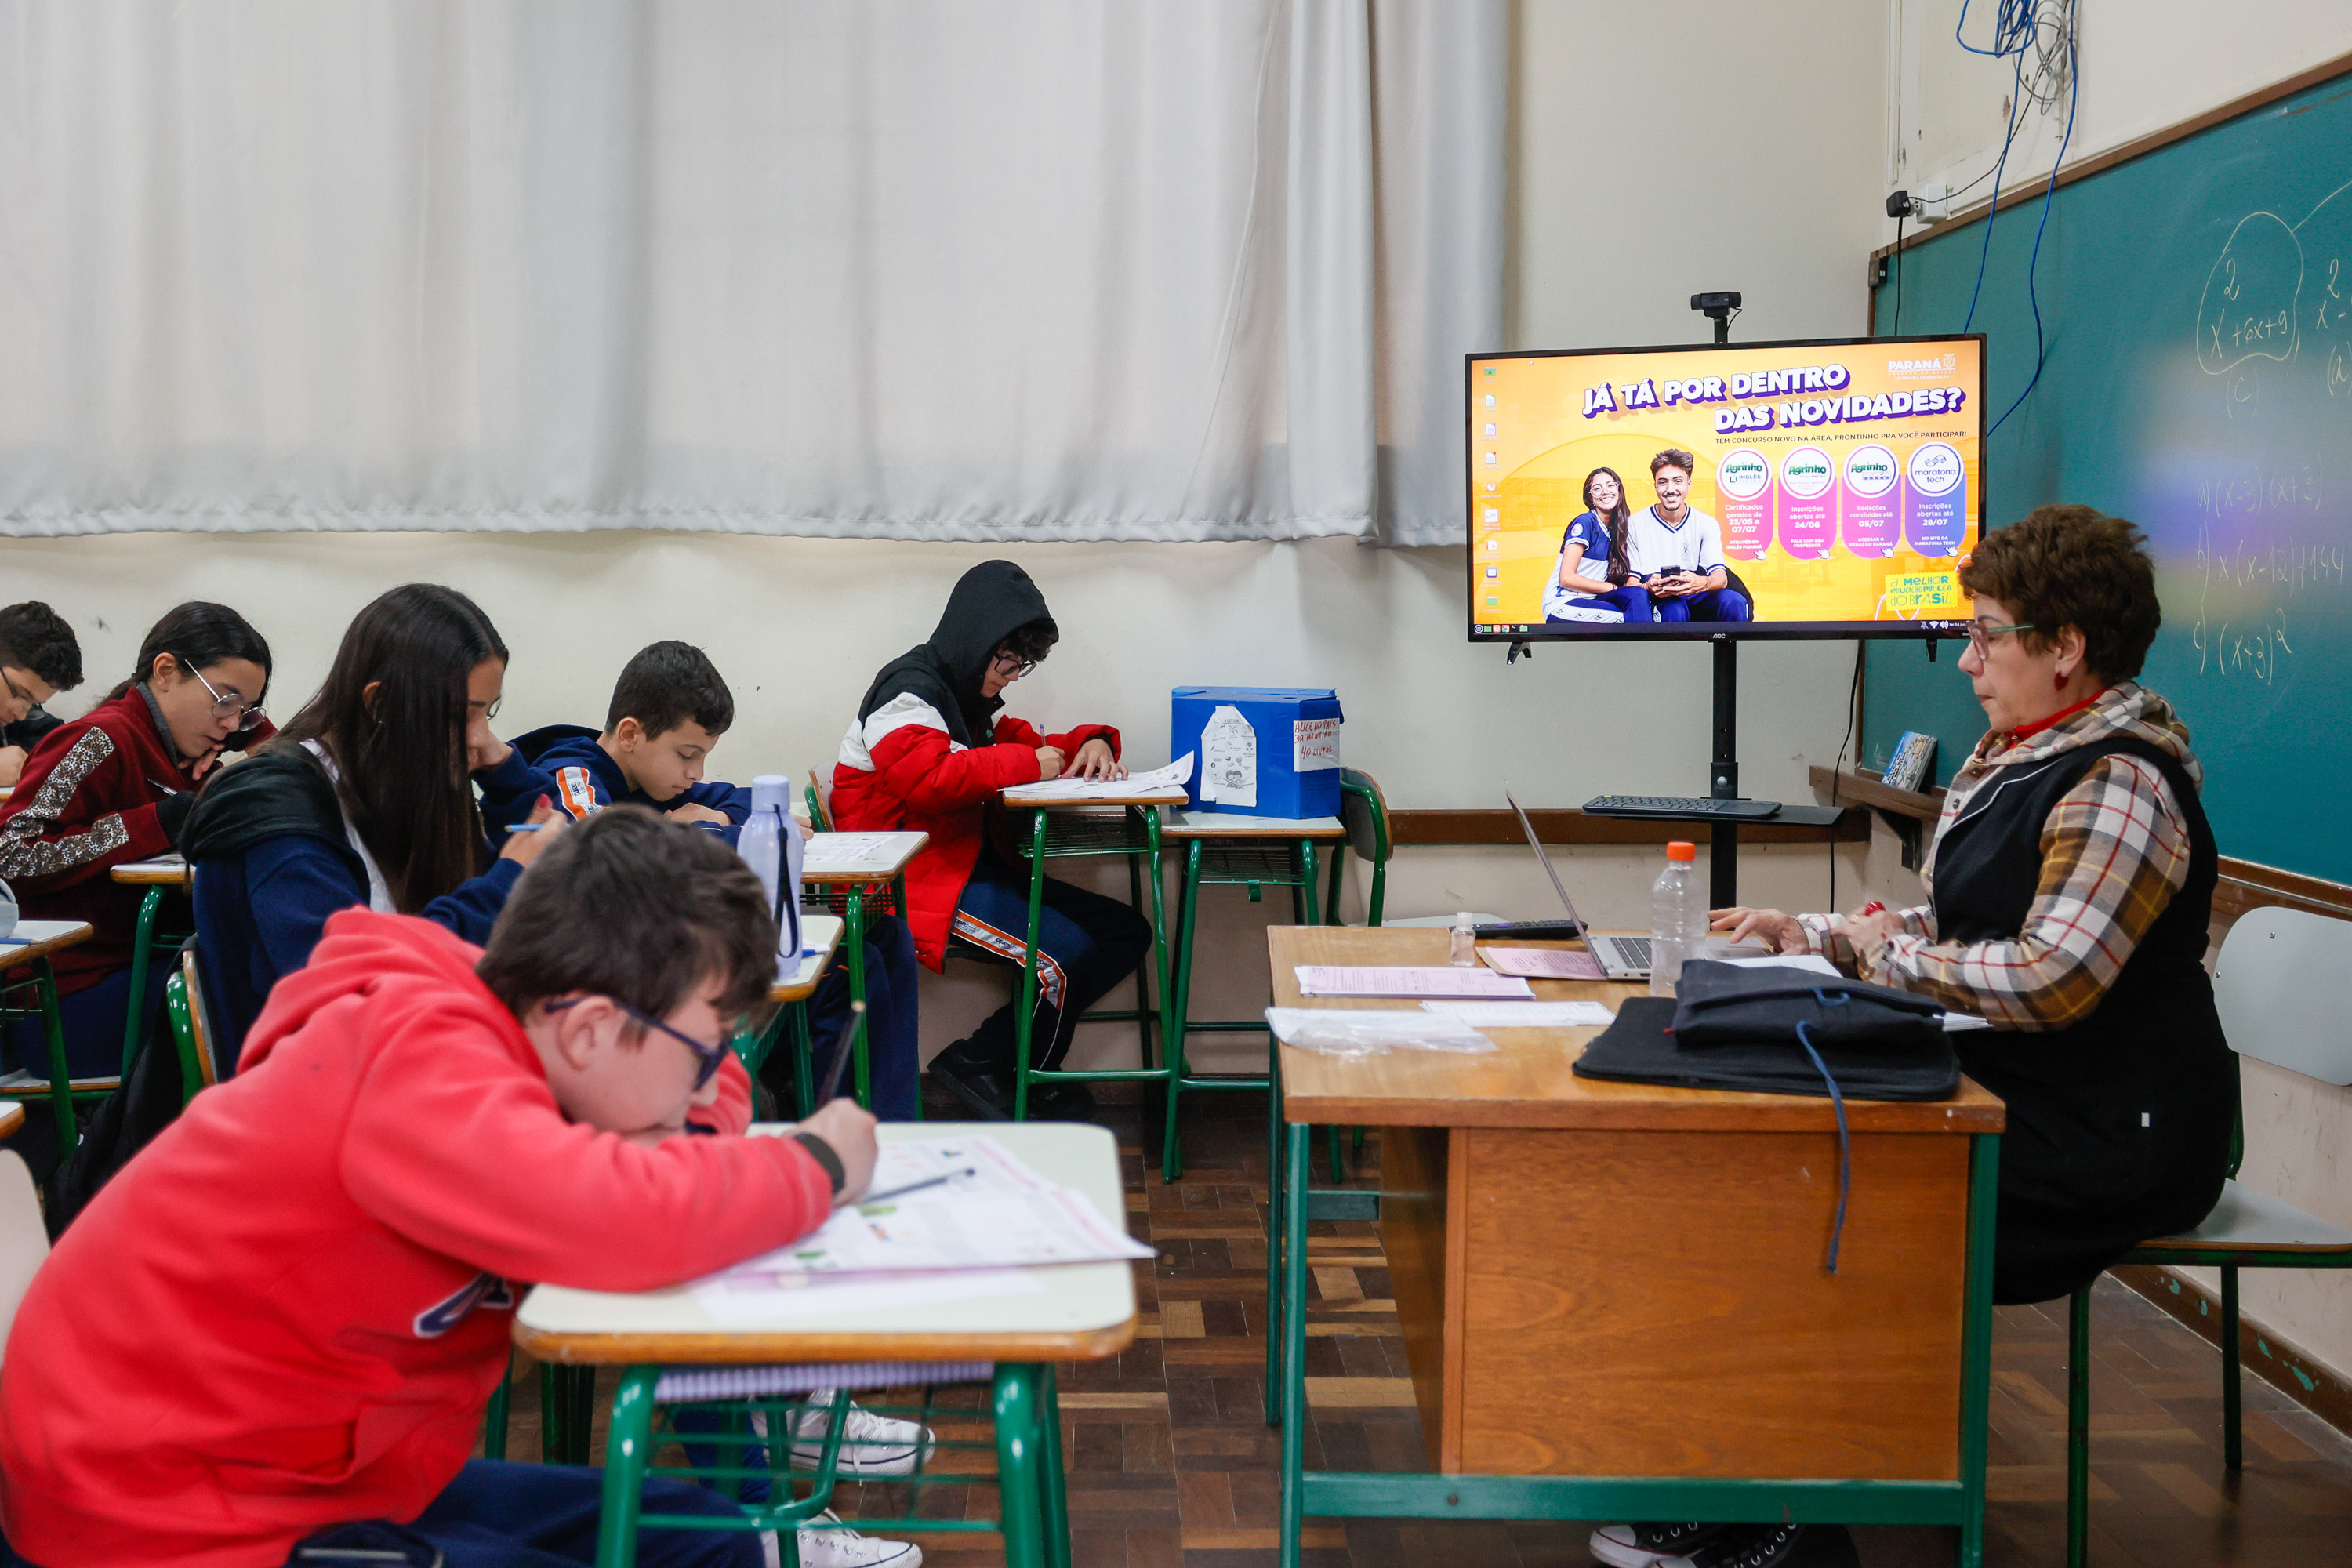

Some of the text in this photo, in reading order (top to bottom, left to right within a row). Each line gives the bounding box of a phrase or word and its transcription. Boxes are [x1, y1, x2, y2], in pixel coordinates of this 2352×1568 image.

[1888, 358, 1941, 371] PARANÁ
[1582, 364, 1849, 417] JÁ TÁ POR DENTRO
[1715, 387, 1965, 434] DAS NOVIDADES?
[1726, 462, 1762, 473] Agrinho
[1789, 463, 1827, 475] Agrinho
[1851, 462, 1888, 473] Agrinho
[1859, 520, 1885, 528] 05/07
[1295, 721, 1312, 733] ALICE
[1314, 721, 1323, 731] NO
[1294, 734, 1304, 743] DA
[1301, 746, 1333, 759] 40 LIVROS
